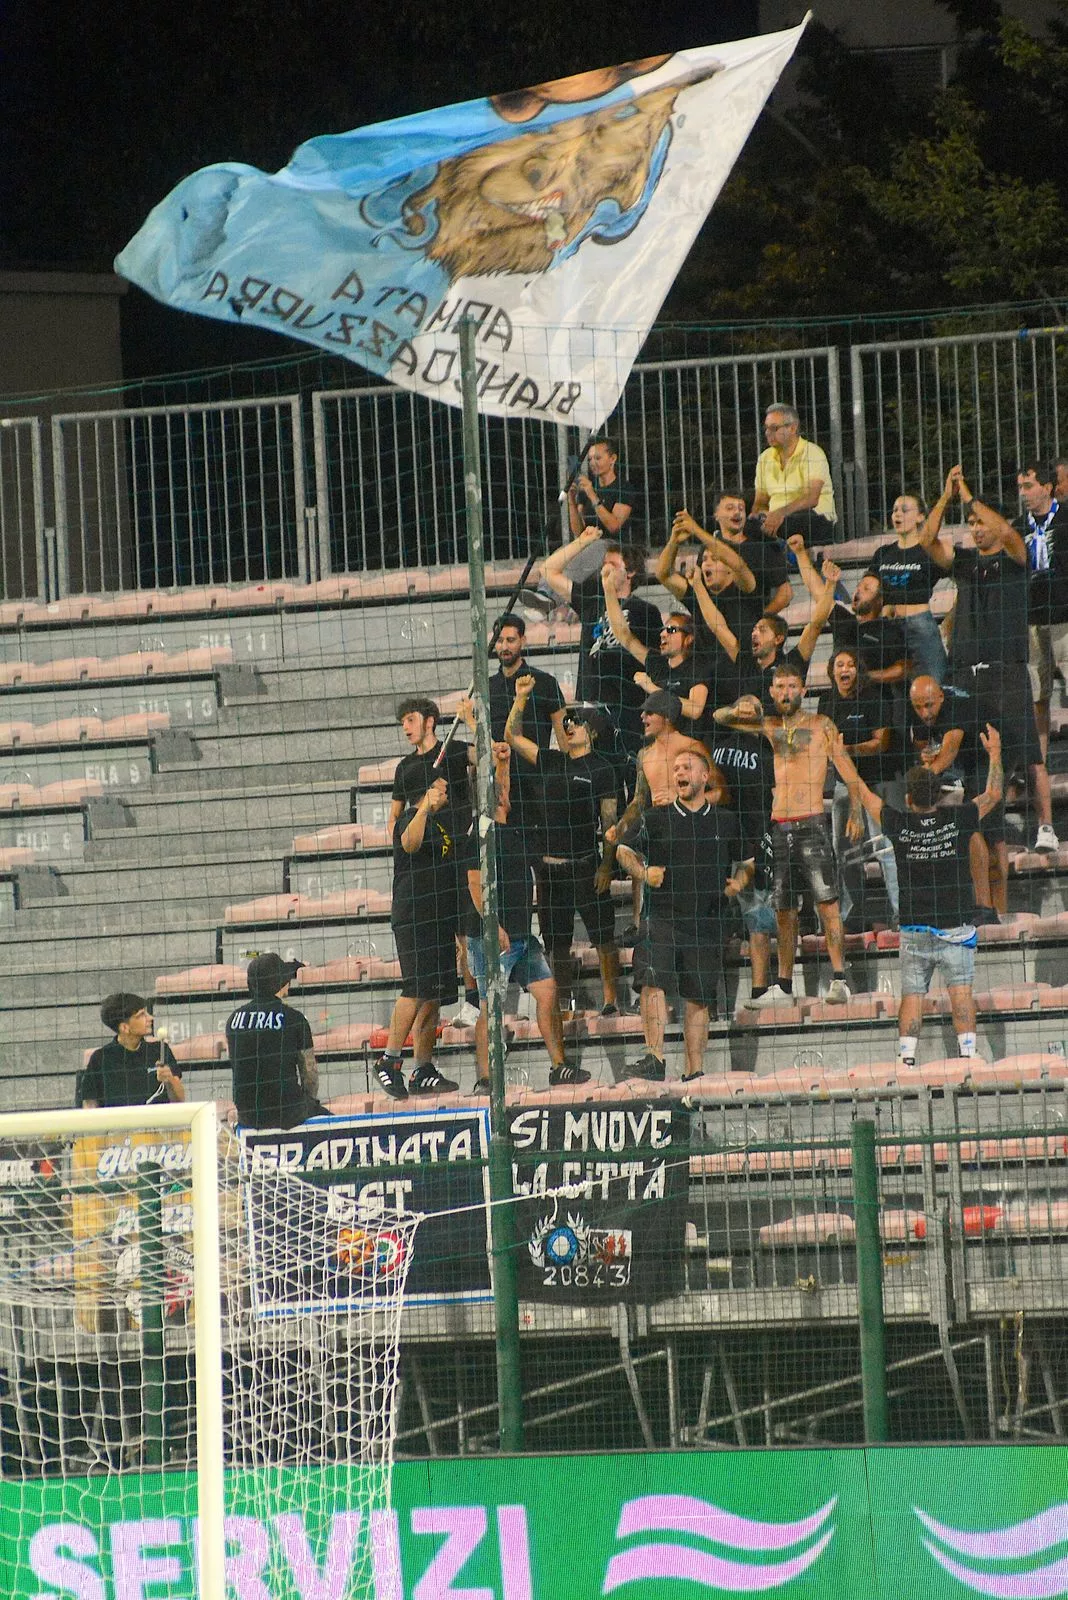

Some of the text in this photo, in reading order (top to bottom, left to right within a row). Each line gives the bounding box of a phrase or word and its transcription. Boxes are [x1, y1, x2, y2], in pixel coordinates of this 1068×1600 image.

[230, 1010, 285, 1030] ULTRAS
[252, 1128, 473, 1174] GRADINATA
[563, 1110, 672, 1152] MUOVE
[327, 1179, 413, 1222] EST
[512, 1161, 549, 1199] LA
[543, 1264, 627, 1288] 20843
[28, 1504, 536, 1600] SERVIZI
